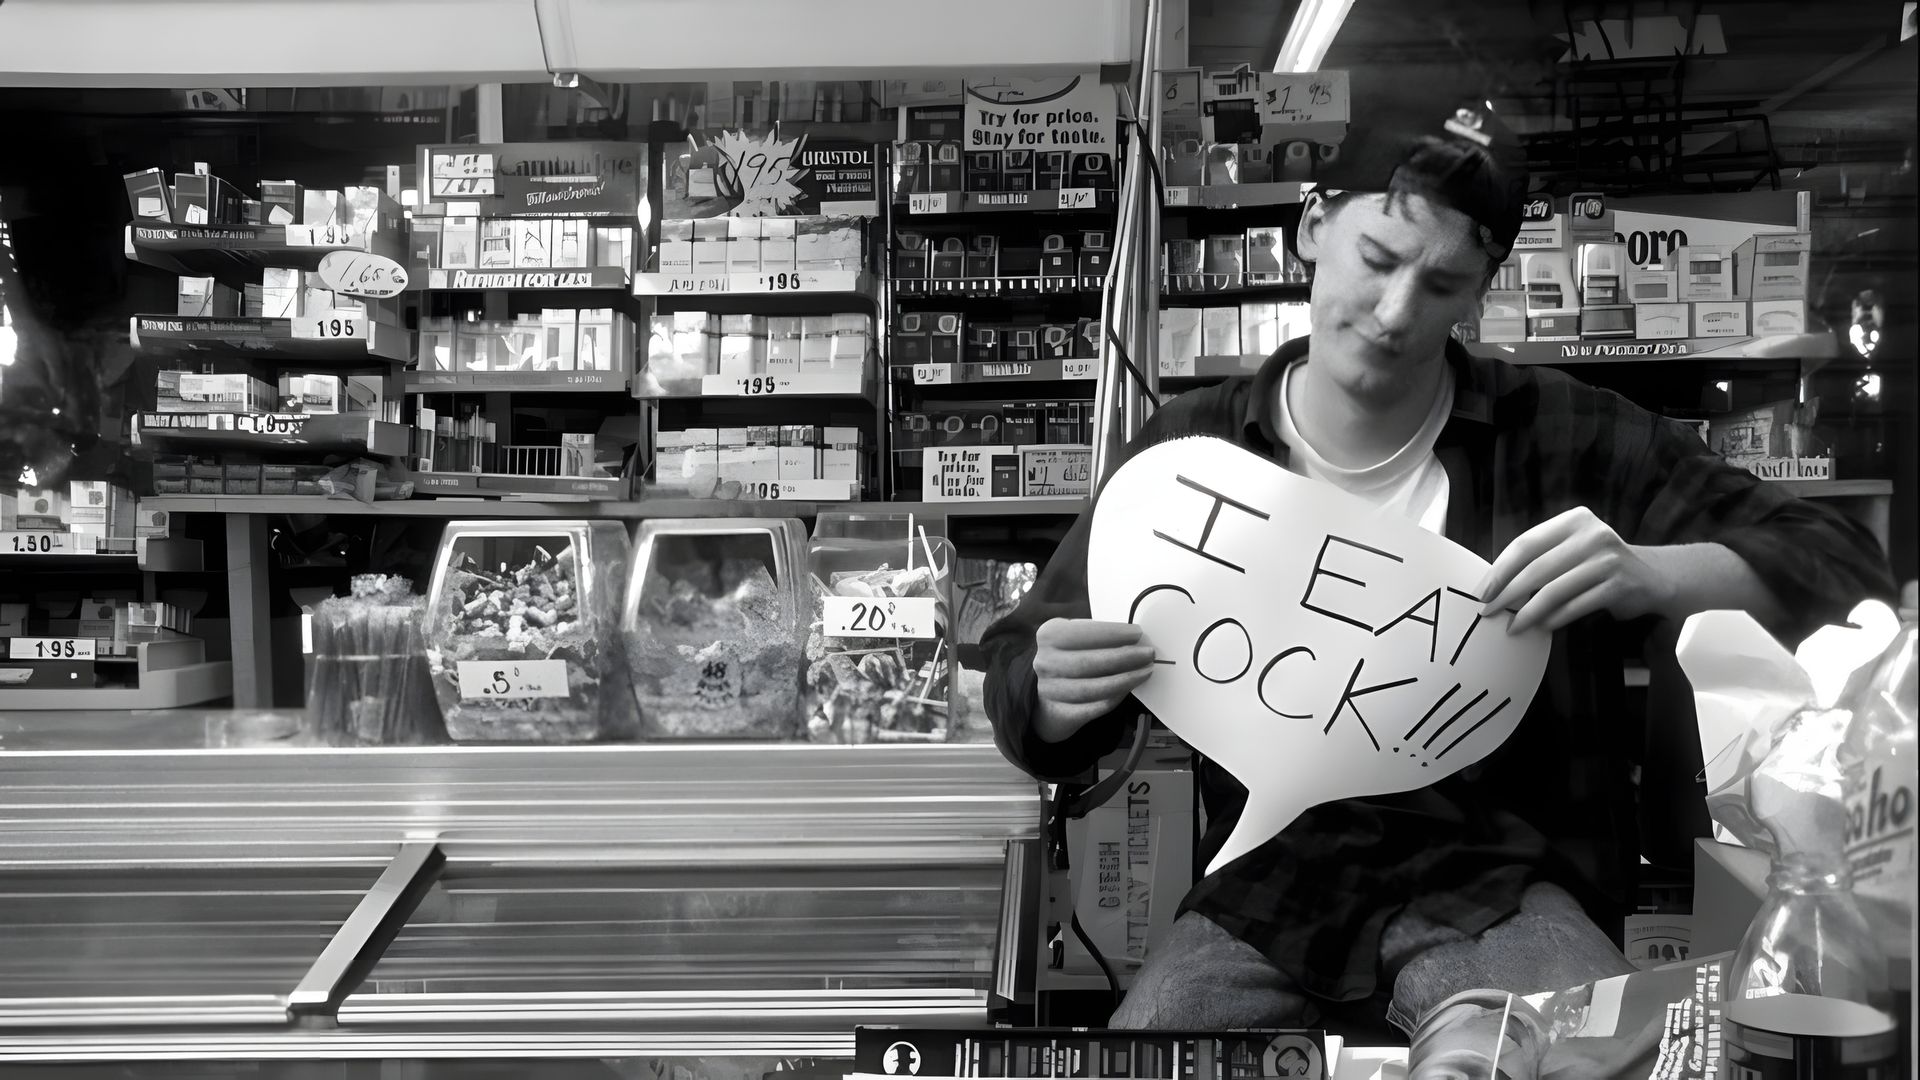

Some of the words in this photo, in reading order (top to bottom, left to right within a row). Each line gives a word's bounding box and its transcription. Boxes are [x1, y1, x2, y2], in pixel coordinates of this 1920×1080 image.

[1614, 229, 1688, 265] oro
[1152, 473, 1271, 575] I
[1301, 534, 1518, 667] EAT
[1128, 583, 1512, 768] COCK!!!
